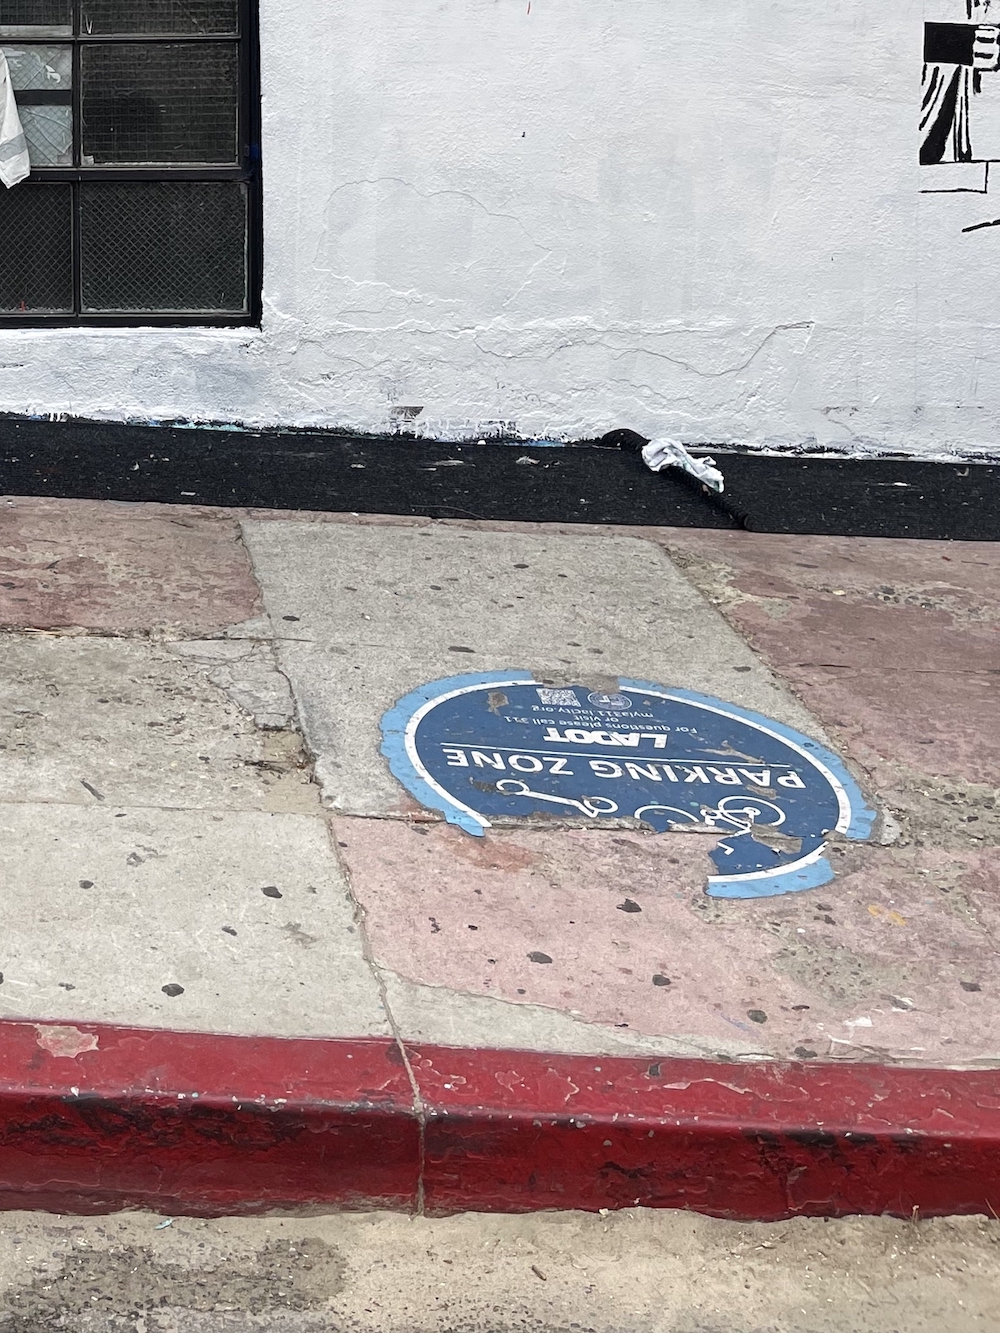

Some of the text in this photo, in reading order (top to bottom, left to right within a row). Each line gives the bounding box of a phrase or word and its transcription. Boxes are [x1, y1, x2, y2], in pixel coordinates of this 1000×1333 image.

[531, 704, 655, 718] myla311.lacity.org
[573, 715, 602, 723] visit
[504, 716, 698, 734] For questions please call 311
[543, 727, 668, 749] LADOT
[442, 748, 807, 789] PARKING ZONE
